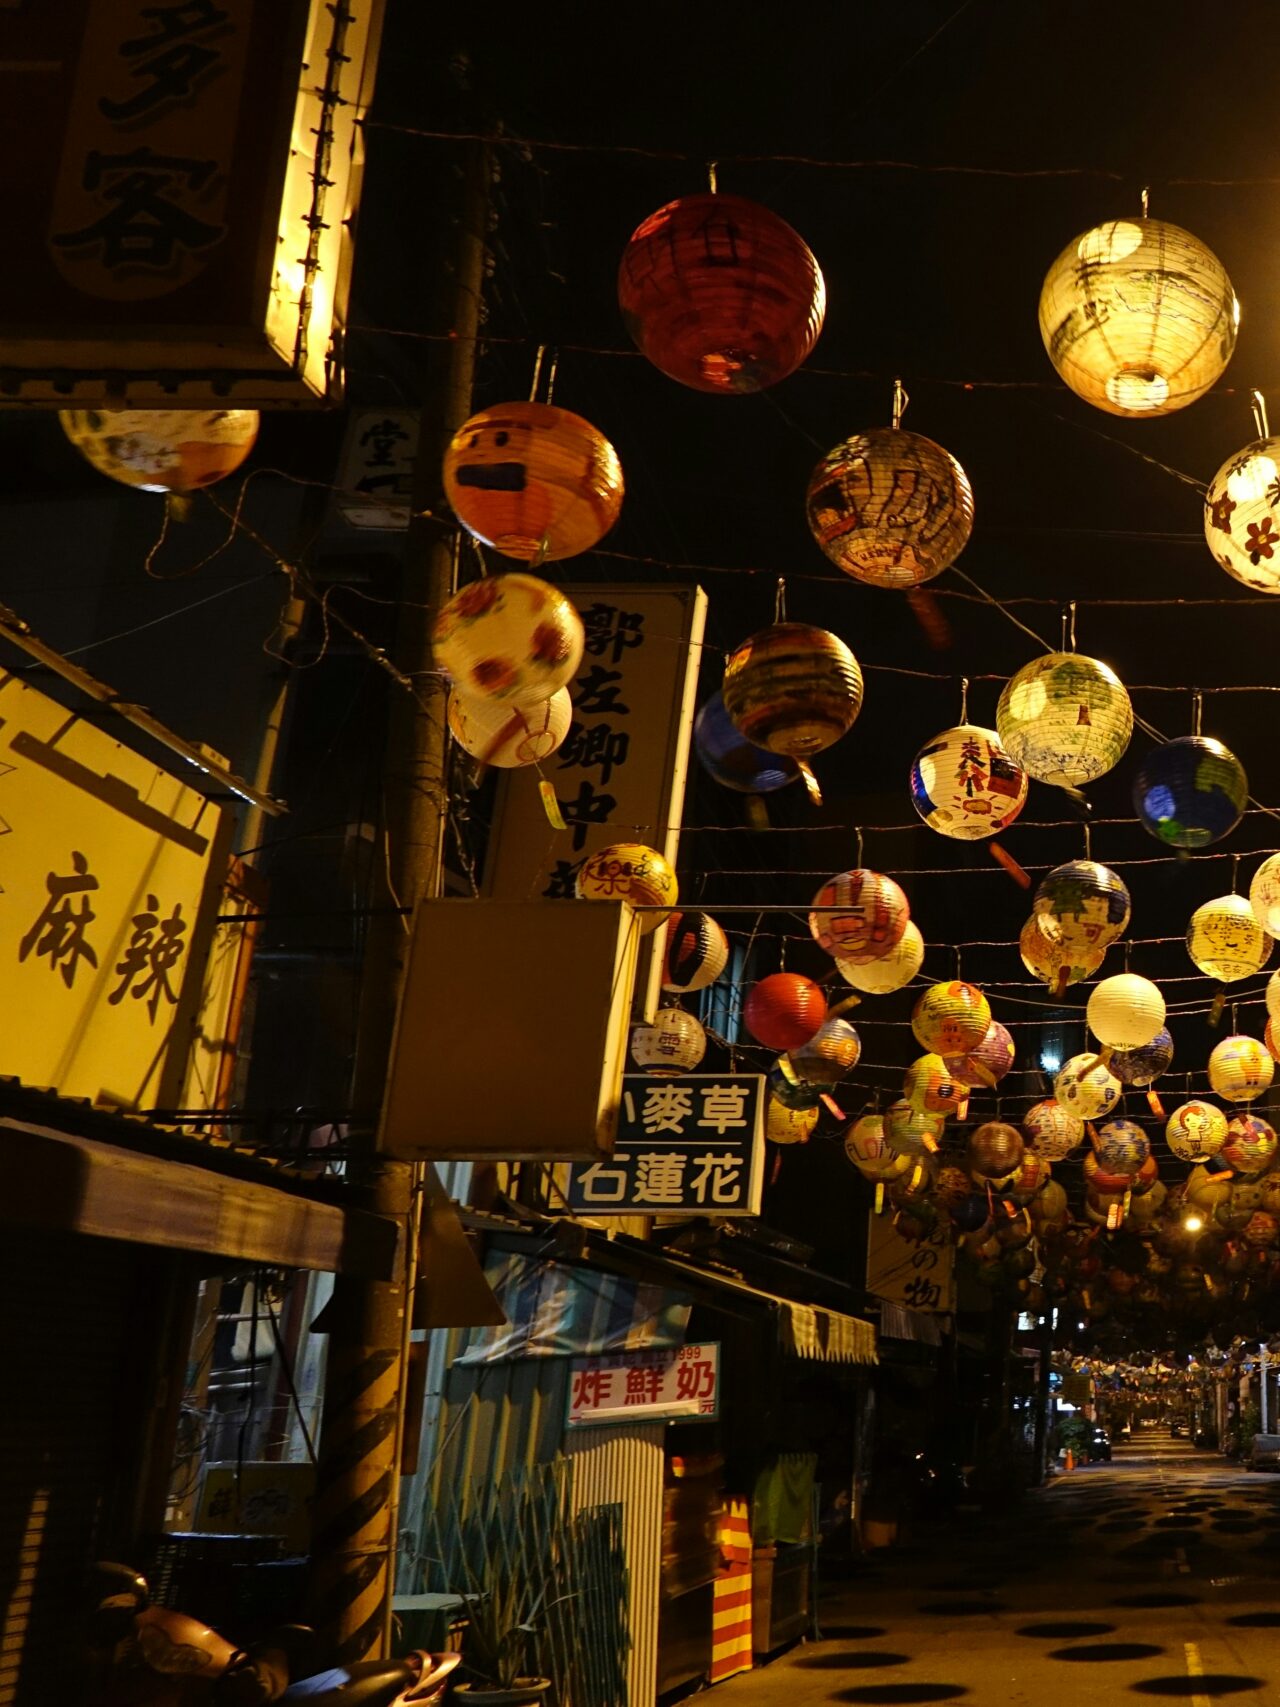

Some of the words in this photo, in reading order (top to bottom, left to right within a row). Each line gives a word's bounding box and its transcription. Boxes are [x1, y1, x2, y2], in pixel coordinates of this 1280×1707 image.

[19, 850, 185, 1026] 麻辣
[577, 1151, 745, 1204] 石蓮花
[573, 1361, 715, 1409] 炸鮮奶
